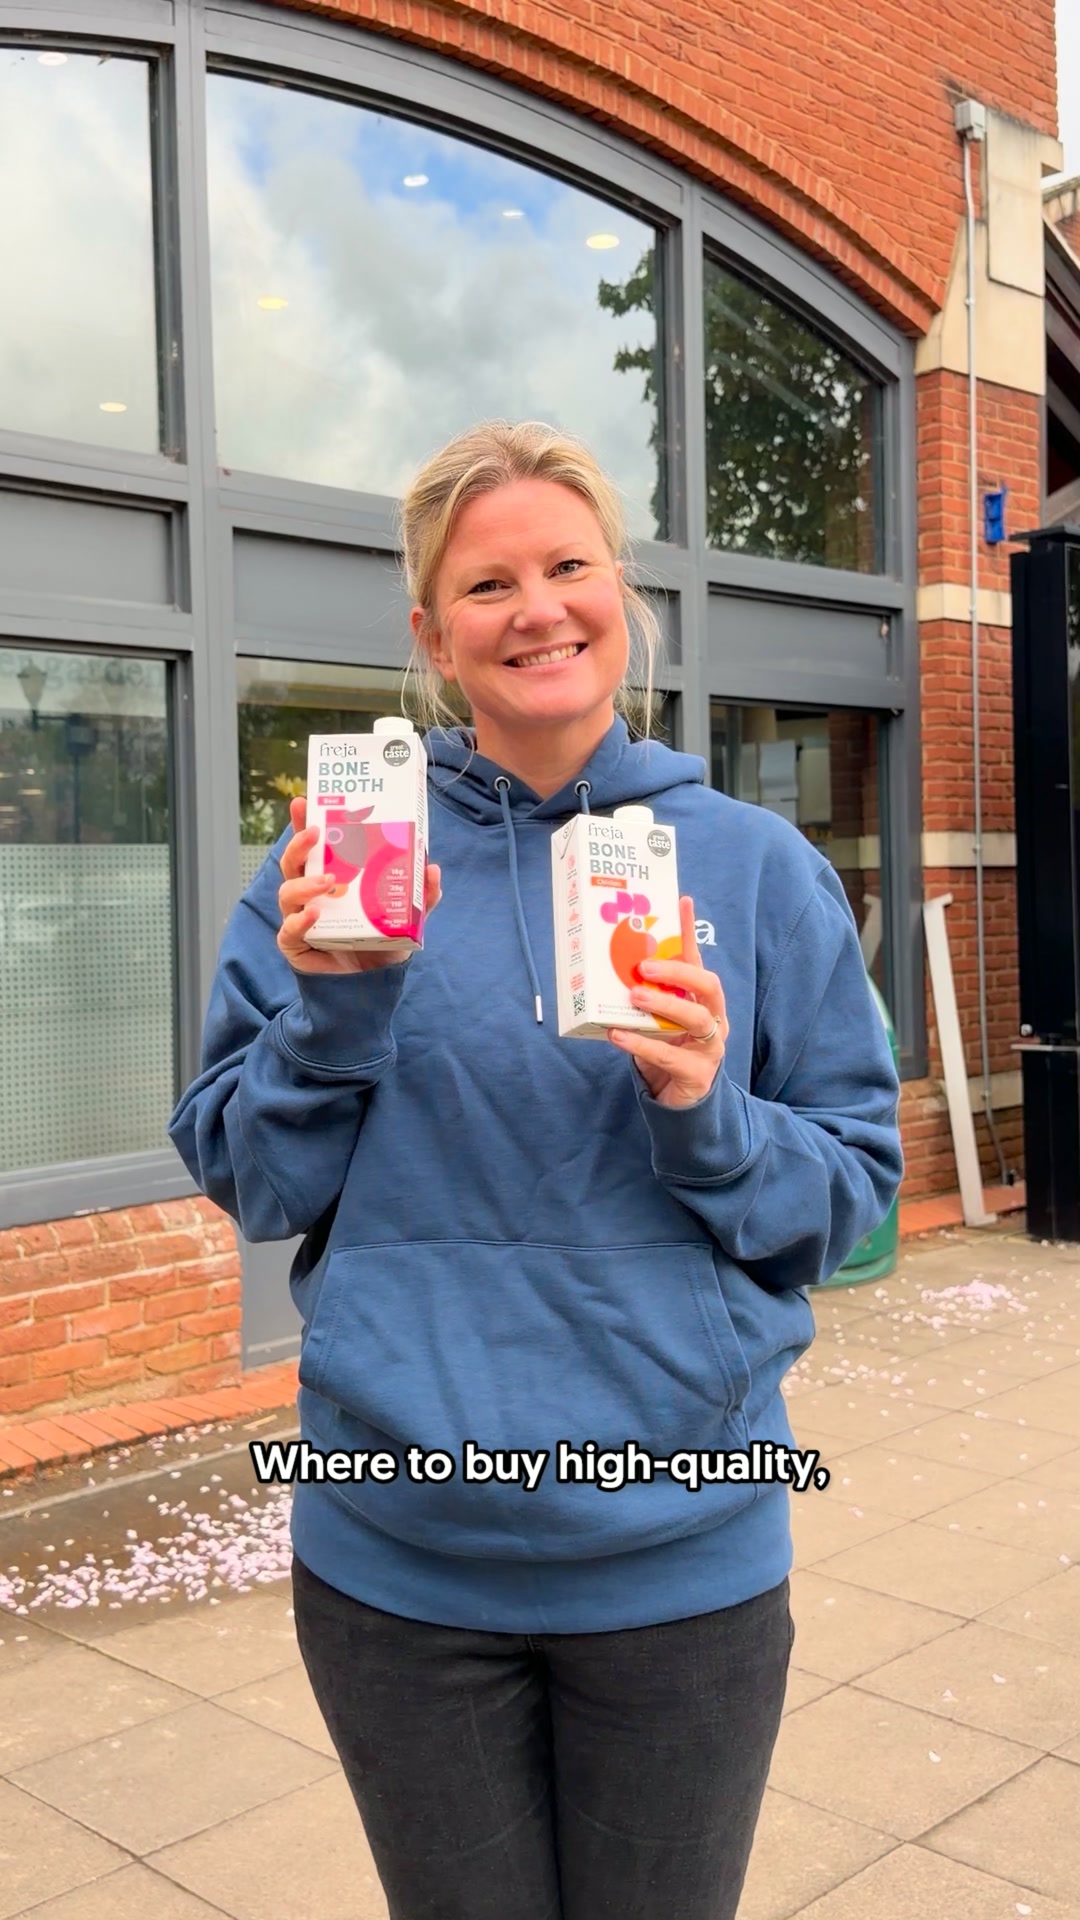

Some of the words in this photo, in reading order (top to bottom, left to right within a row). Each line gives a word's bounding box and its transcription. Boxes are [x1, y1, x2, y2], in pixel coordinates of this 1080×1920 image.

[320, 743, 357, 758] freja
[385, 748, 410, 758] taste
[319, 761, 370, 776] BONE
[318, 778, 384, 793] BROTH
[588, 823, 624, 840] freja
[588, 841, 637, 860] BONE
[648, 839, 671, 849] taste
[590, 859, 649, 880] BROTH
